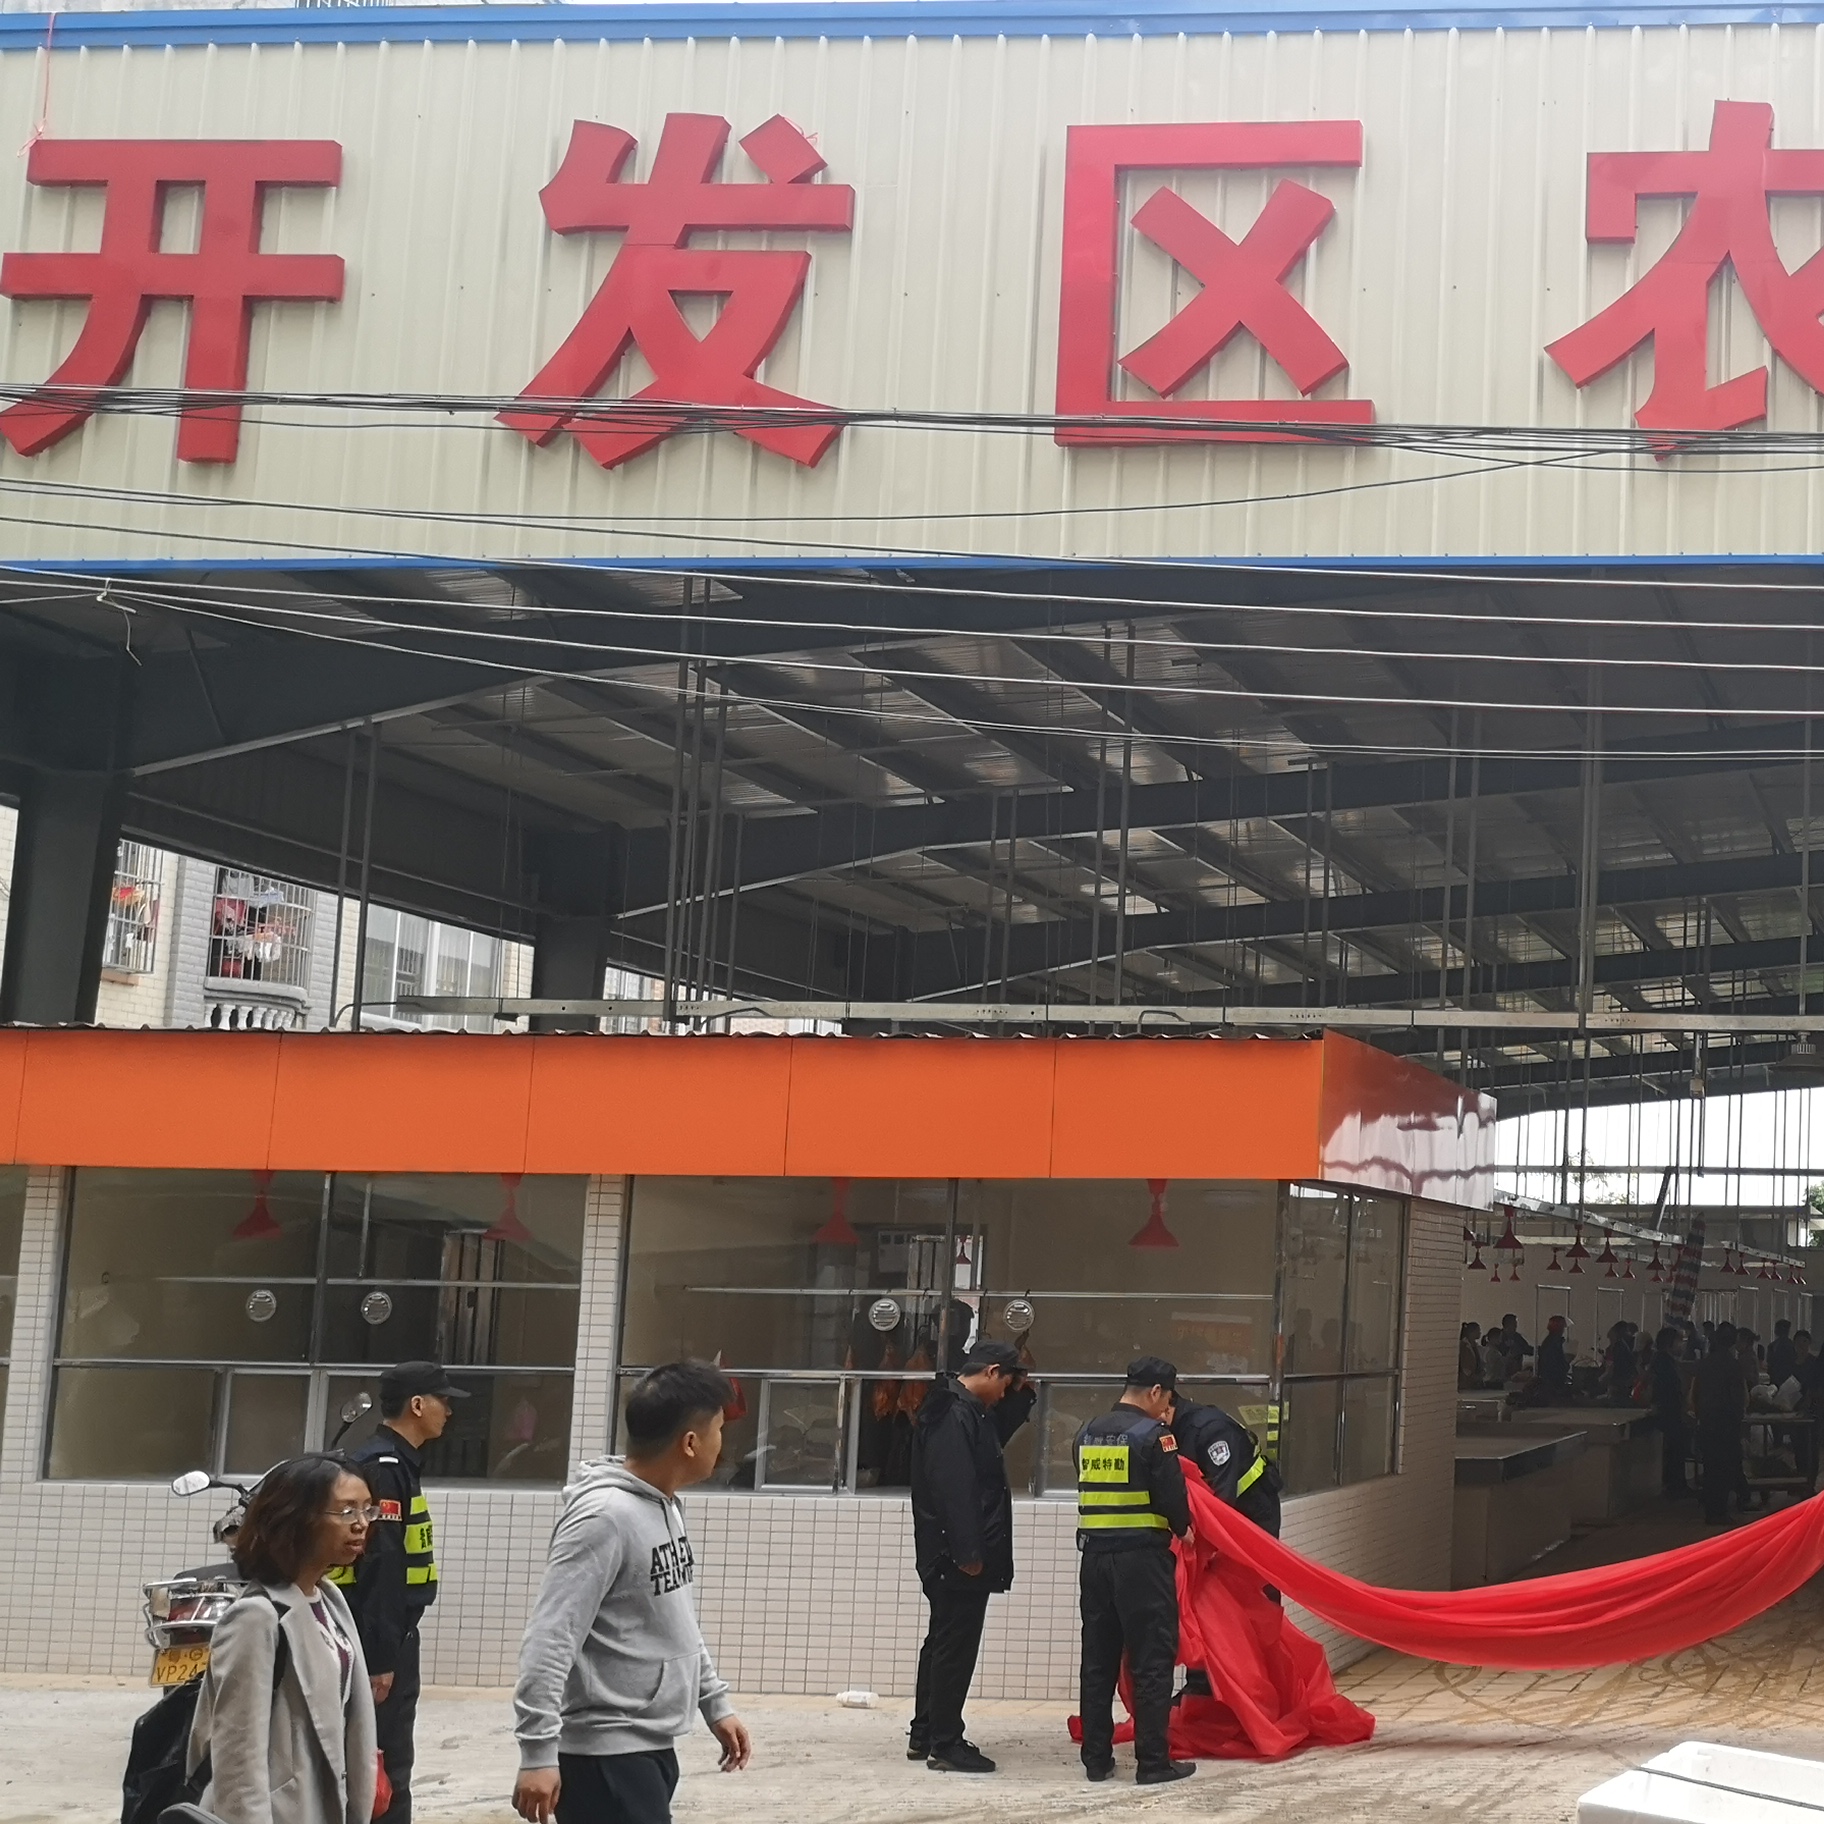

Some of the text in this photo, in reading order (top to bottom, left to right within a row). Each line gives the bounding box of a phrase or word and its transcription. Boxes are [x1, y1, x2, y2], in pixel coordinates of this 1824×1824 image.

[1082, 1457, 1125, 1471] 智威特勤
[156, 1662, 206, 1682] VP24
